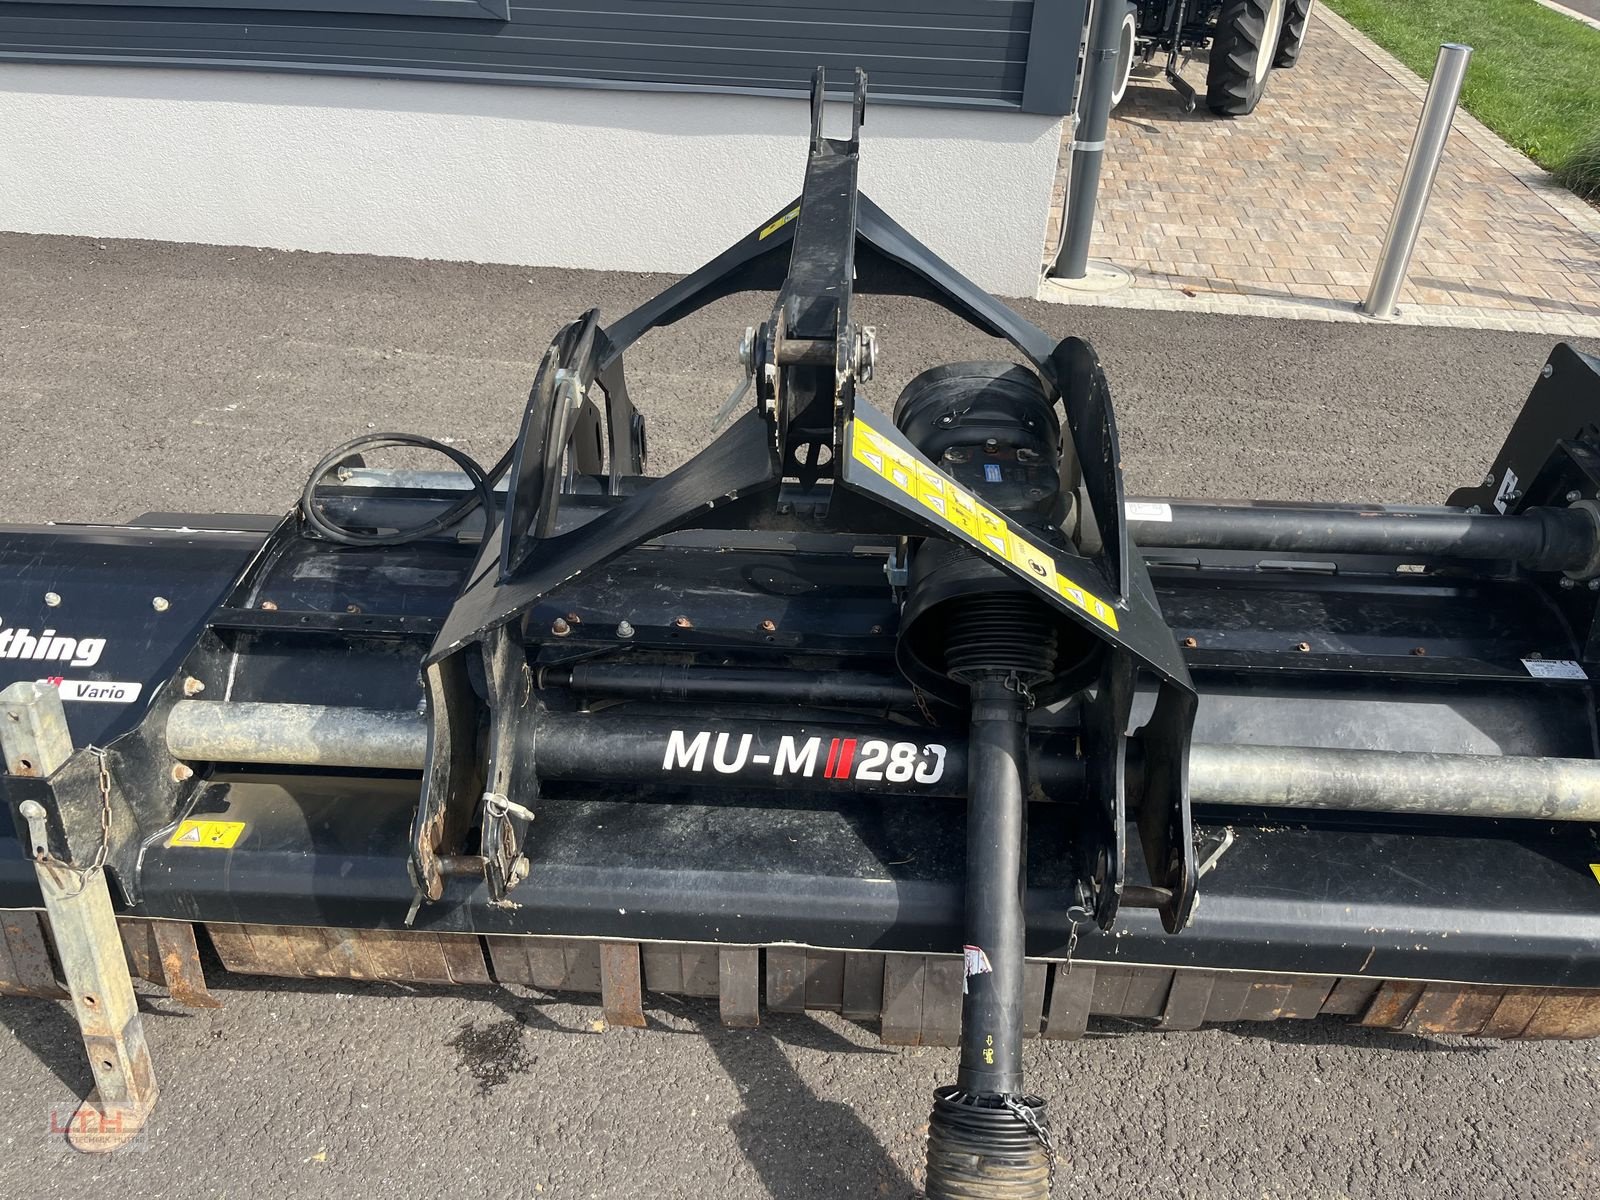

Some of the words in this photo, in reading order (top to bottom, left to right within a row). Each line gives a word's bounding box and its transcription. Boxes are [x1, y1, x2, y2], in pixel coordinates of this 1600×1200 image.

[0, 628, 106, 667] thing
[76, 684, 125, 699] Vario
[855, 740, 947, 784] 280
